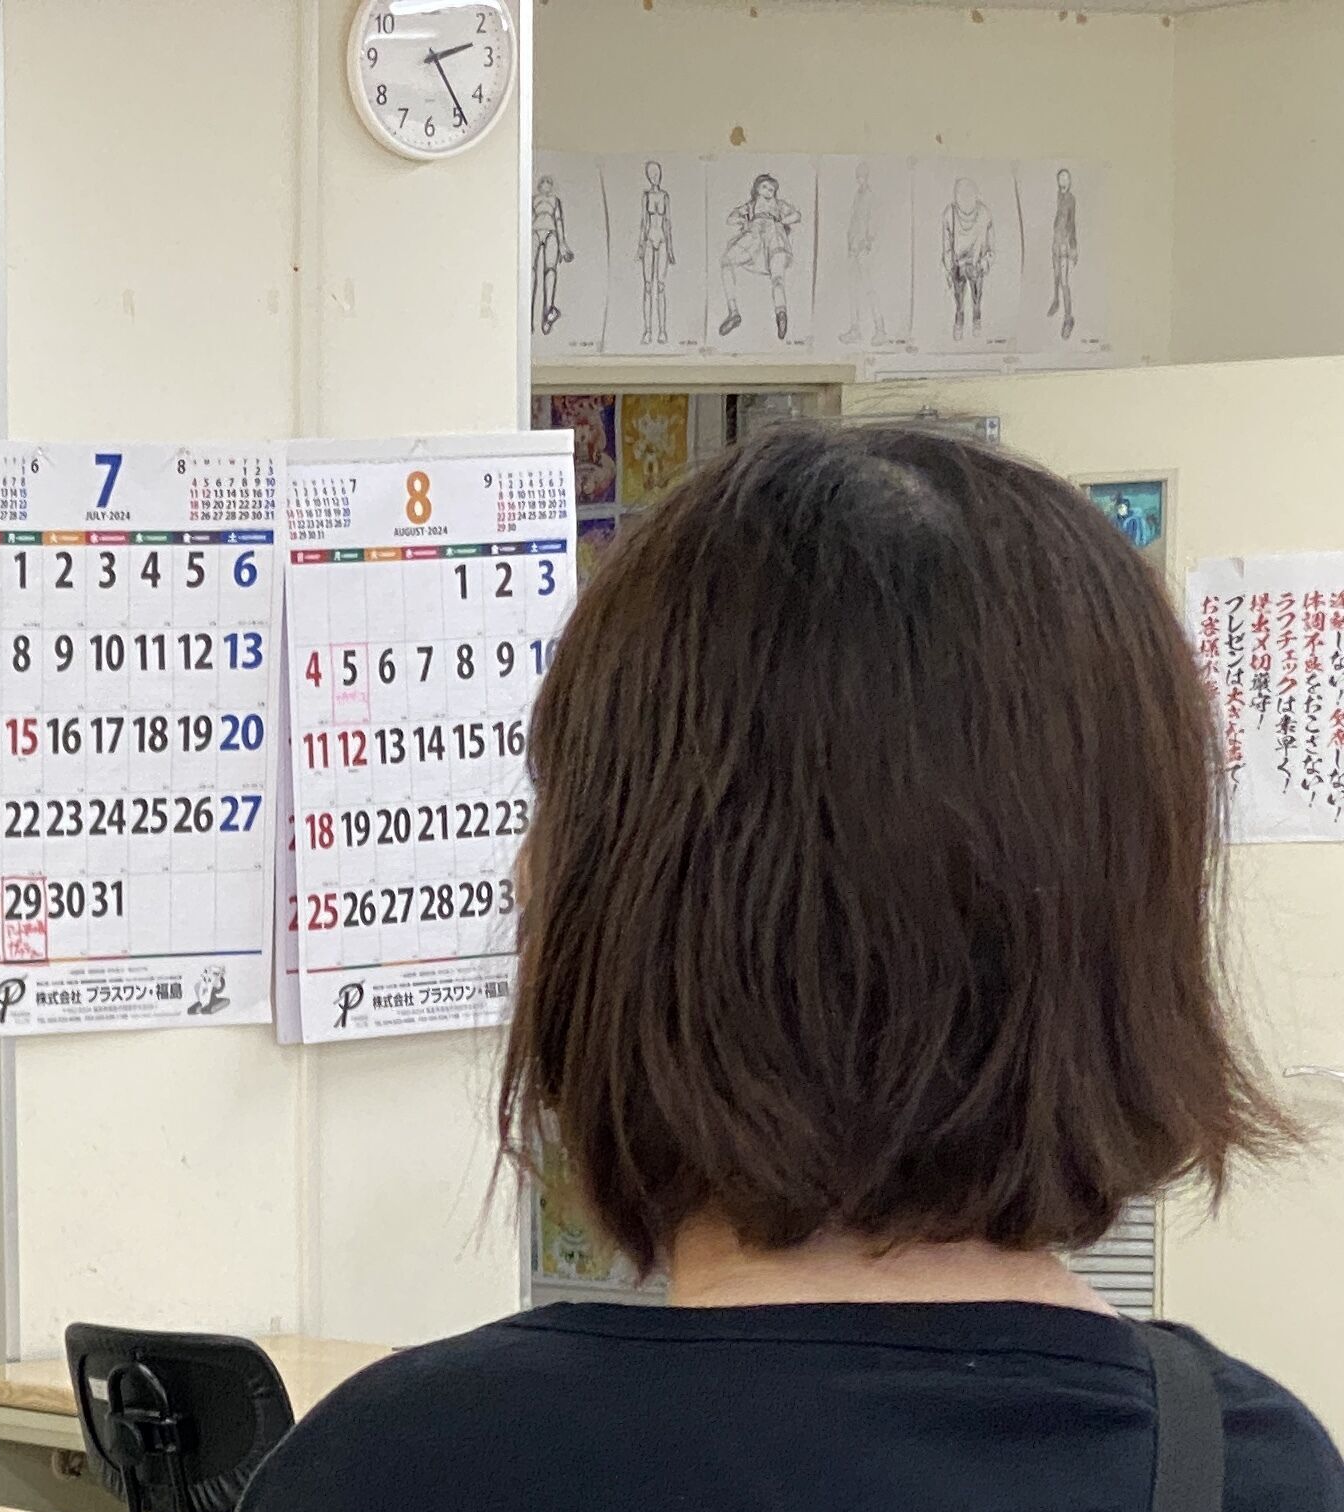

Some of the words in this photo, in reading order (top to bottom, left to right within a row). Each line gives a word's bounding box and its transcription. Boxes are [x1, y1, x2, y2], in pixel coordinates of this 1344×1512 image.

[375, 13, 395, 34] 10
[476, 13, 487, 34] 2
[367, 47, 378, 68] 9
[483, 47, 494, 67] 3
[376, 84, 387, 105] 8
[471, 83, 483, 104] 4
[398, 107, 409, 128] 7
[424, 115, 435, 137] 6
[452, 107, 463, 128] 5
[31, 459, 39, 474] 6
[177, 459, 186, 474] 8
[96, 454, 122, 508] 7
[349, 479, 356, 493] 7
[484, 473, 493, 488] 9
[406, 471, 431, 524] 8
[15, 552, 26, 588] 1
[56, 552, 73, 588] 2
[99, 552, 116, 588] 3
[141, 552, 160, 588] 4
[187, 552, 204, 588] 5
[234, 551, 257, 587] 6
[455, 565, 467, 599] 1
[496, 562, 512, 597] 2
[538, 560, 555, 595] 3
[13, 635, 30, 672] 8
[55, 635, 73, 672] 9
[90, 634, 124, 671] 10
[135, 634, 165, 670] 11
[178, 633, 213, 669] 12
[224, 632, 262, 669] 13
[306, 652, 321, 687] 4
[344, 650, 357, 686] 5
[379, 648, 395, 684] 6
[417, 646, 433, 681] 7
[457, 644, 474, 679] 8
[497, 642, 514, 677] 9
[6, 719, 37, 755] 15
[47, 718, 81, 754] 16
[91, 717, 124, 753] 17
[133, 716, 168, 752] 18
[178, 715, 212, 751] 19
[220, 714, 264, 750] 20
[304, 732, 328, 768] 11
[338, 730, 367, 766] 12
[375, 728, 405, 764] 13
[413, 726, 445, 761] 14
[453, 723, 484, 759] 15
[492, 720, 526, 757] 16
[5, 801, 40, 838] 22
[47, 800, 83, 836] 23
[89, 799, 126, 835] 24
[132, 798, 167, 834] 25
[174, 796, 213, 833] 26
[220, 795, 262, 831] 27
[306, 813, 334, 849] 18
[341, 811, 370, 846] 19
[377, 808, 411, 844] 20
[418, 805, 448, 841] 21
[456, 802, 489, 838] 22
[496, 799, 531, 837] 23
[5, 883, 41, 920] 29
[48, 882, 85, 919] 30
[92, 881, 122, 917] 31
[308, 893, 338, 930] 25
[344, 890, 376, 927] 26
[381, 887, 414, 924] 27
[420, 884, 454, 921] 28
[459, 881, 493, 917] 29
